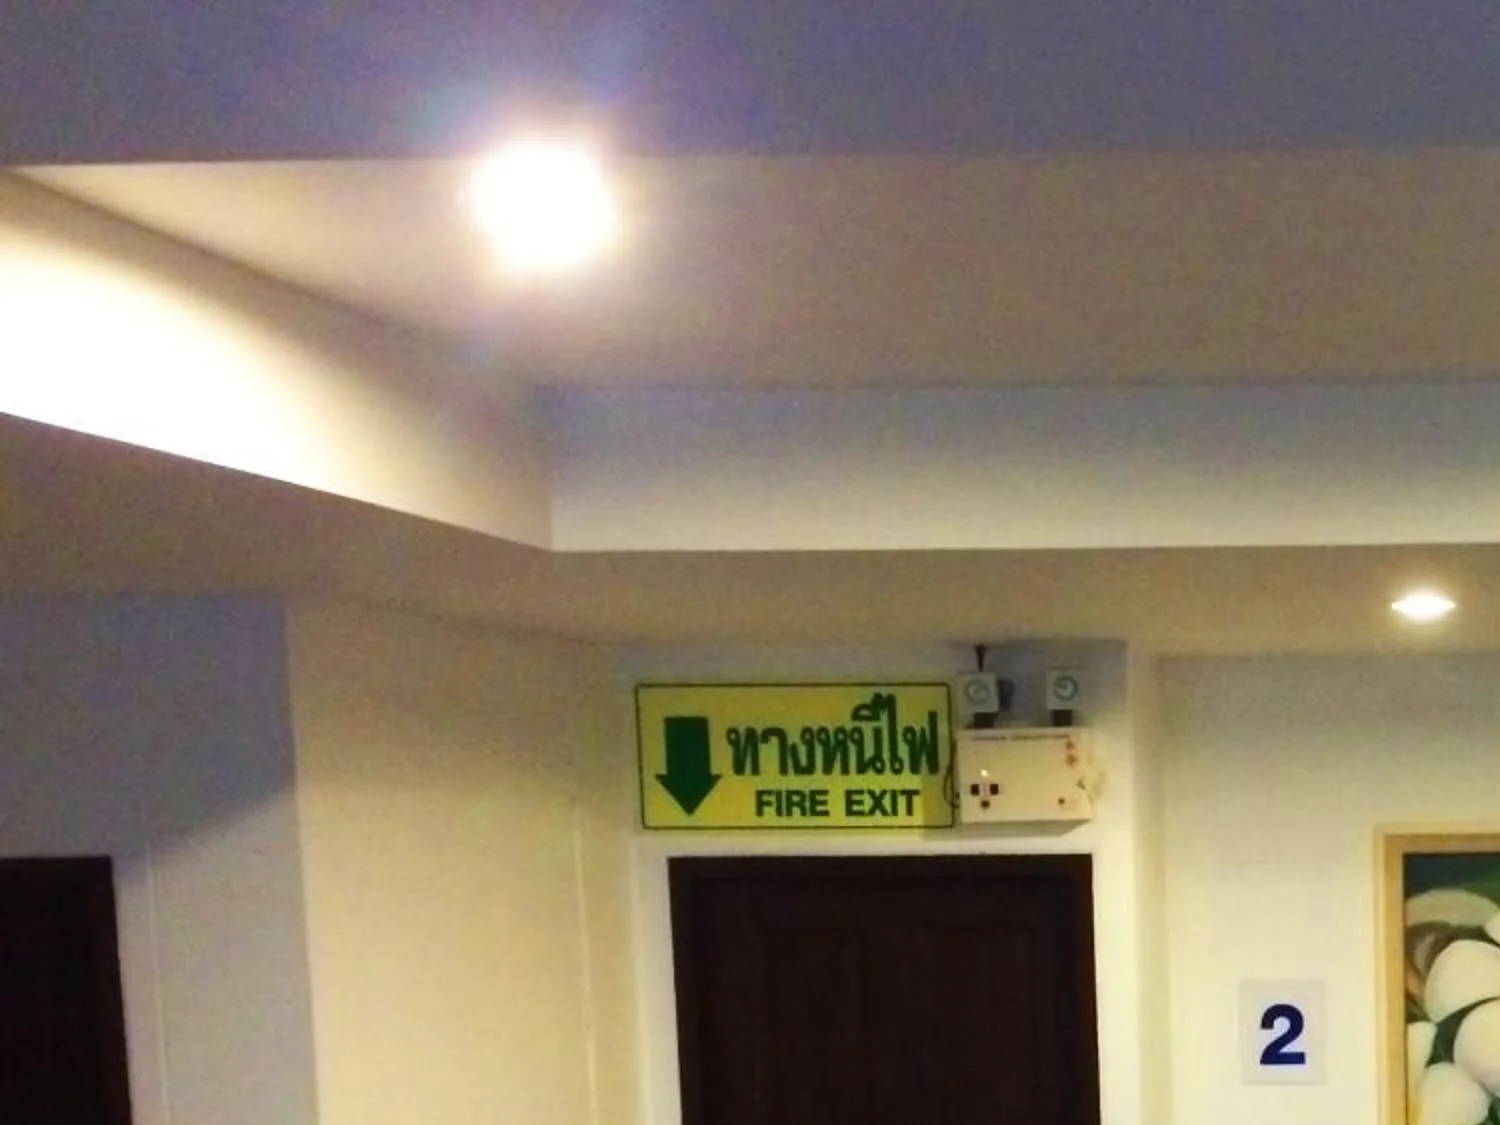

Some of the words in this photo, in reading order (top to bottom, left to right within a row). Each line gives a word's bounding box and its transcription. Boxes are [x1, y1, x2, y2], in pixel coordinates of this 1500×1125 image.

[725, 692, 940, 777] ทางหนีไฟ
[754, 788, 831, 818] FIRE
[844, 788, 921, 818] EXIT
[1259, 1003, 1306, 1066] 2
